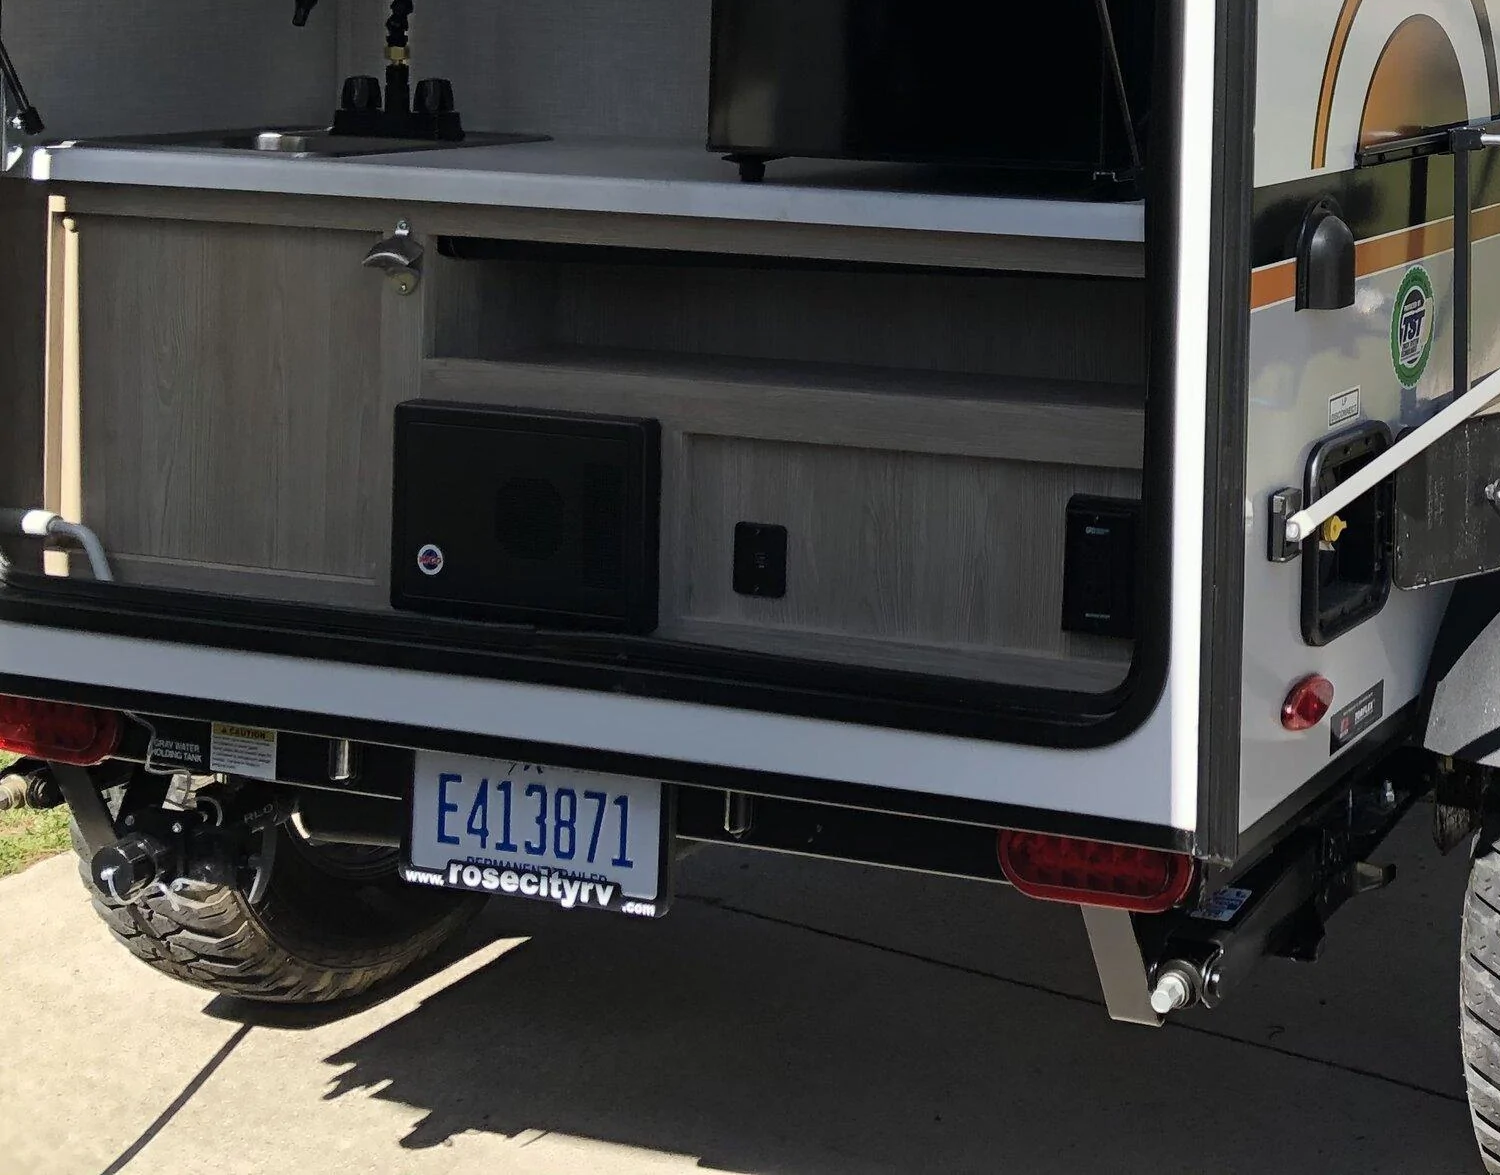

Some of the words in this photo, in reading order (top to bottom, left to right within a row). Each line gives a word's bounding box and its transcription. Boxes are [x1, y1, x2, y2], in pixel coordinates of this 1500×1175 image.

[1402, 311, 1426, 343] TST
[229, 725, 266, 739] CAUTION
[437, 772, 634, 869] E413871
